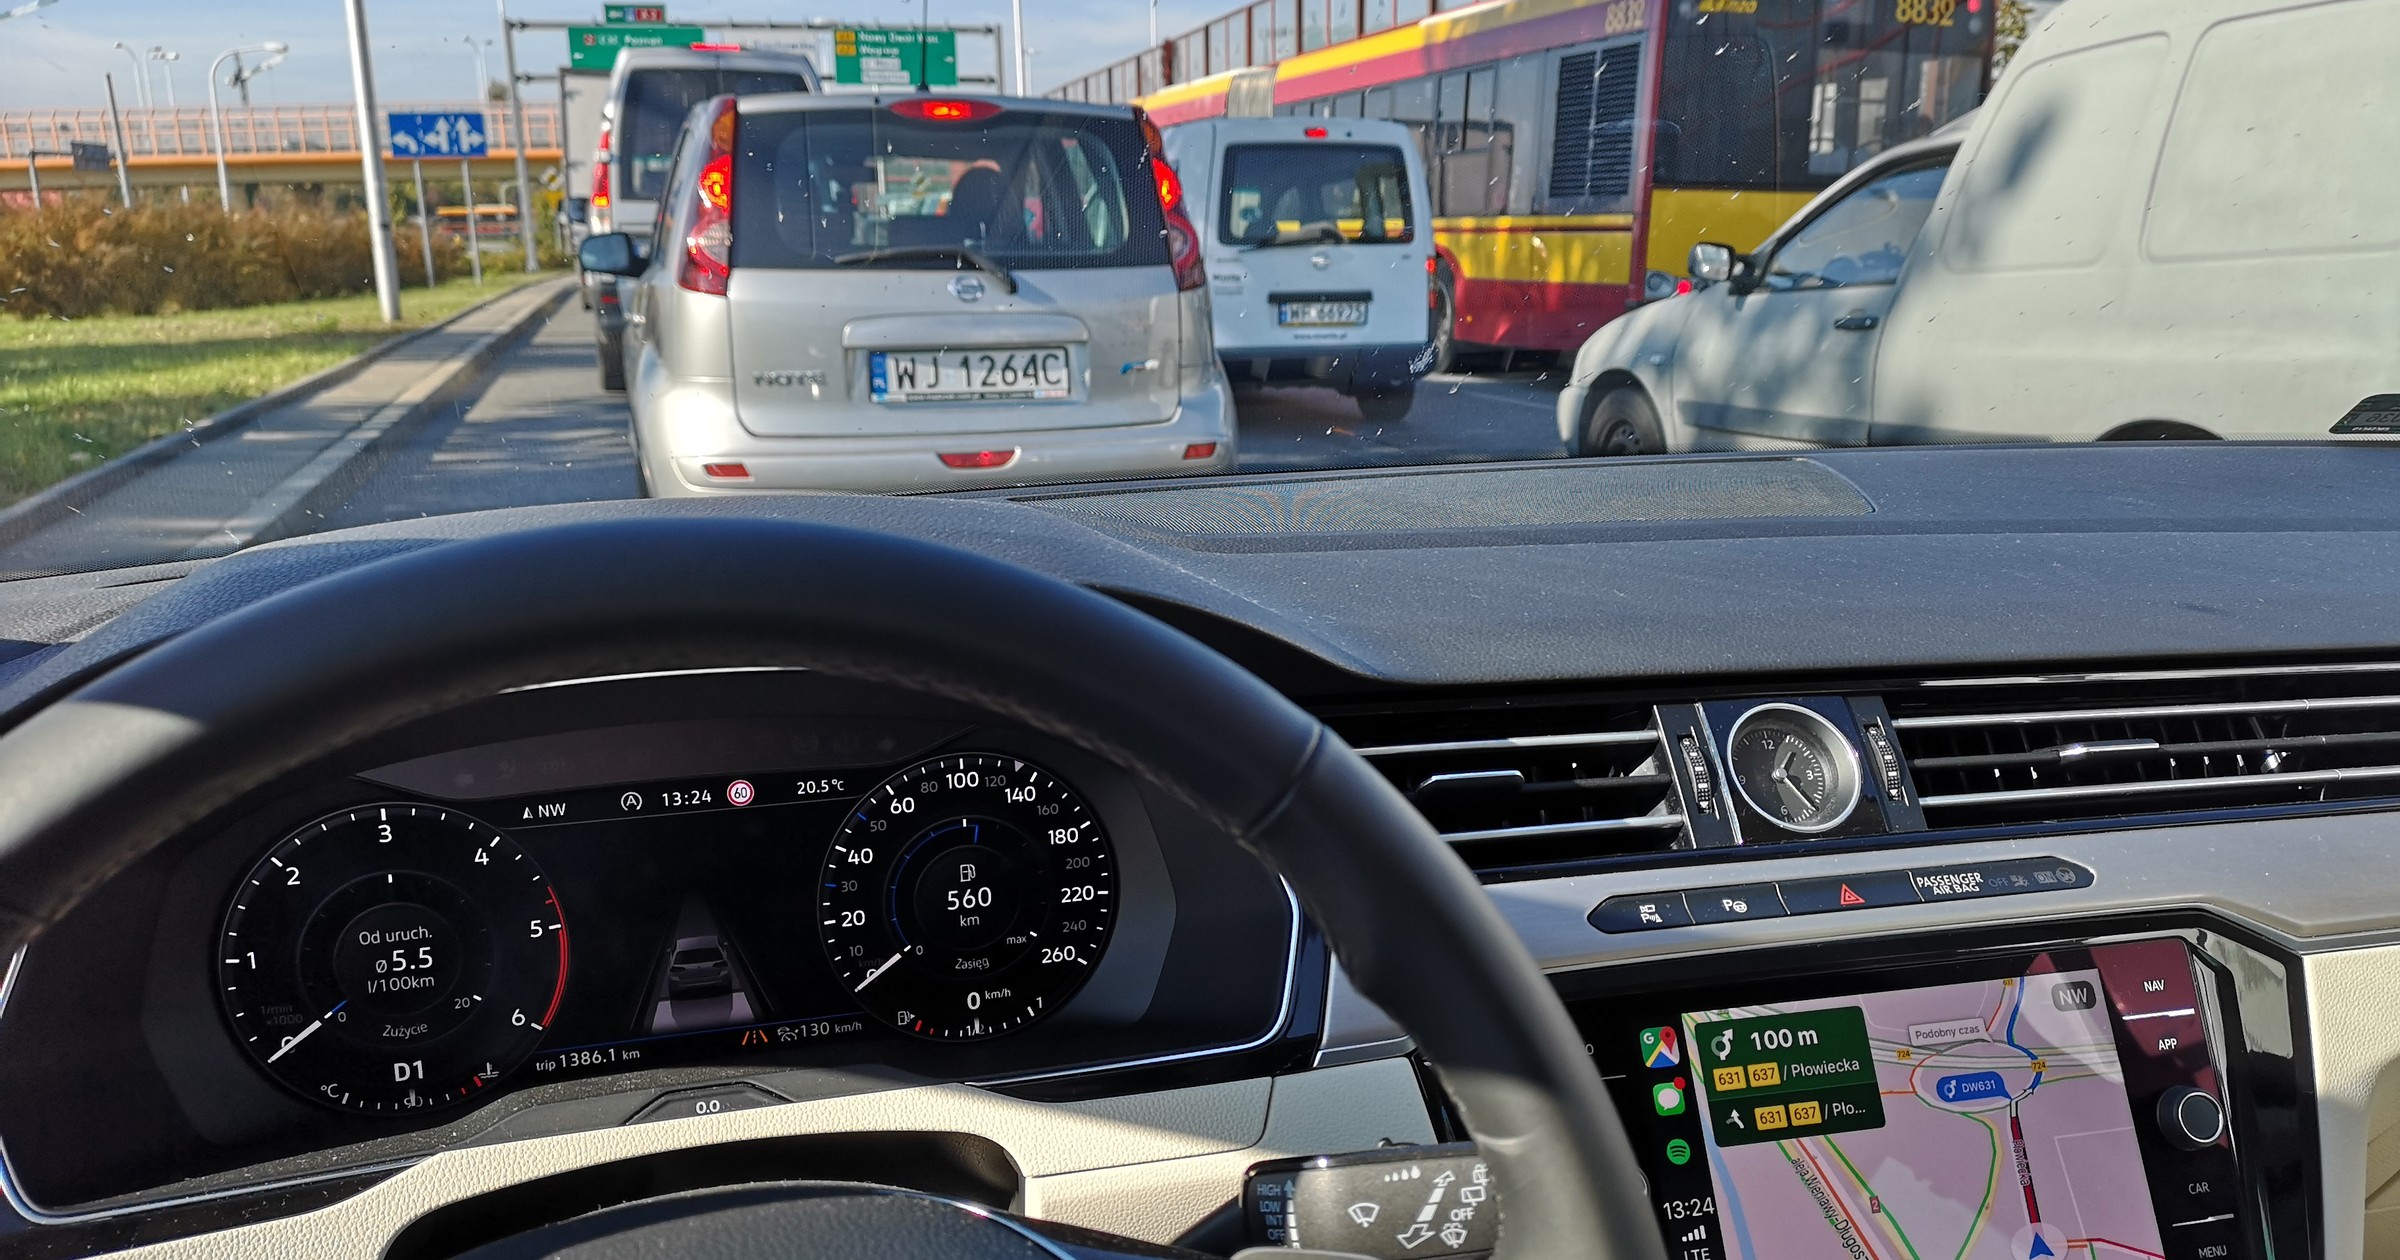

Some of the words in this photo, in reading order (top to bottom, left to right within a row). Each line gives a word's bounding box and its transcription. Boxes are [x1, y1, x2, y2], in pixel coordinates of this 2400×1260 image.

[1896, 0, 1954, 26] 8832
[896, 356, 939, 389] WJ
[960, 353, 1062, 389] 1264C
[1762, 740, 1775, 750] 12
[946, 772, 979, 790] 100
[984, 775, 1006, 788] 120
[1738, 775, 1746, 785] 9
[1806, 770, 1814, 780] 3
[734, 787, 748, 799] 60
[797, 778, 845, 795] 20.5°C
[920, 781, 938, 794] 80
[662, 790, 712, 806] 13:24
[1004, 786, 1036, 804] 140
[538, 803, 566, 818] NW
[890, 797, 915, 814] 60
[1036, 803, 1059, 816] 160
[1780, 805, 1788, 815] 6
[870, 820, 887, 832] 50
[378, 824, 393, 843] 3
[1048, 828, 1079, 845] 180
[474, 848, 490, 866] 4
[848, 848, 874, 865] 40
[1066, 856, 1090, 870] 200
[286, 866, 301, 886] 2
[1916, 872, 1984, 888] PASSENGER
[1988, 878, 2009, 888] OFF
[2038, 872, 2055, 882] ON
[841, 880, 858, 892] 30
[1933, 884, 1951, 896] AIR
[1956, 883, 1980, 894] BAG
[948, 886, 992, 910] 560
[1060, 885, 1094, 903] 220
[841, 910, 866, 928] 20
[960, 915, 980, 926] km
[1062, 920, 1087, 932] 240
[358, 930, 380, 945] Od
[386, 926, 433, 942] uruch.
[530, 919, 544, 938] 5
[1006, 935, 1027, 944] max
[849, 945, 864, 956] 10
[916, 946, 924, 956] 0
[1041, 946, 1076, 964] 260
[246, 951, 256, 970] 1
[955, 958, 990, 970] Zasięg
[2144, 980, 2165, 992] NAV
[966, 992, 981, 1010] 0
[985, 988, 1012, 1000] km/h
[1036, 996, 1043, 1008] 1
[2058, 987, 2088, 1006] NW
[454, 998, 470, 1010] 20
[338, 1012, 346, 1022] 0
[512, 1008, 526, 1026] 6
[382, 1022, 428, 1040] Zużycie
[800, 1022, 830, 1038] 130
[834, 1021, 862, 1034] km/h
[1915, 1026, 1956, 1040] Podobny
[1959, 1024, 1980, 1036] czas
[1750, 1028, 1792, 1050] 100
[1798, 1029, 1818, 1046] m
[2158, 1038, 2178, 1050] APP
[536, 1060, 556, 1072] trip
[559, 1048, 616, 1068] 1386.1
[622, 1049, 640, 1060] km
[1896, 1050, 1910, 1059] 724
[393, 1060, 424, 1082] D1
[1718, 1072, 1742, 1086] 631
[1752, 1068, 1776, 1082] 637
[1791, 1058, 1860, 1078] Płowiecka
[2032, 1061, 2046, 1070] 724
[1962, 1080, 1996, 1093] DW631
[1760, 1110, 1782, 1124] 631
[1794, 1106, 1816, 1120] 637
[1832, 1102, 1866, 1117] Pło...
[1256, 1184, 1281, 1196] HIGH
[2188, 1182, 2210, 1194] CAR
[1260, 1201, 1280, 1212] LOW
[1663, 1196, 1714, 1220] 13:24
[1791, 1158, 1810, 1177] aleja
[1805, 1174, 1870, 1260] Wieniawy-Długos
[1872, 1200, 1879, 1210] 2
[1266, 1214, 1283, 1226] INT
[1450, 1207, 1475, 1221] OFF
[1268, 1228, 1286, 1240] OFF
[2198, 1244, 2227, 1258] MENU
